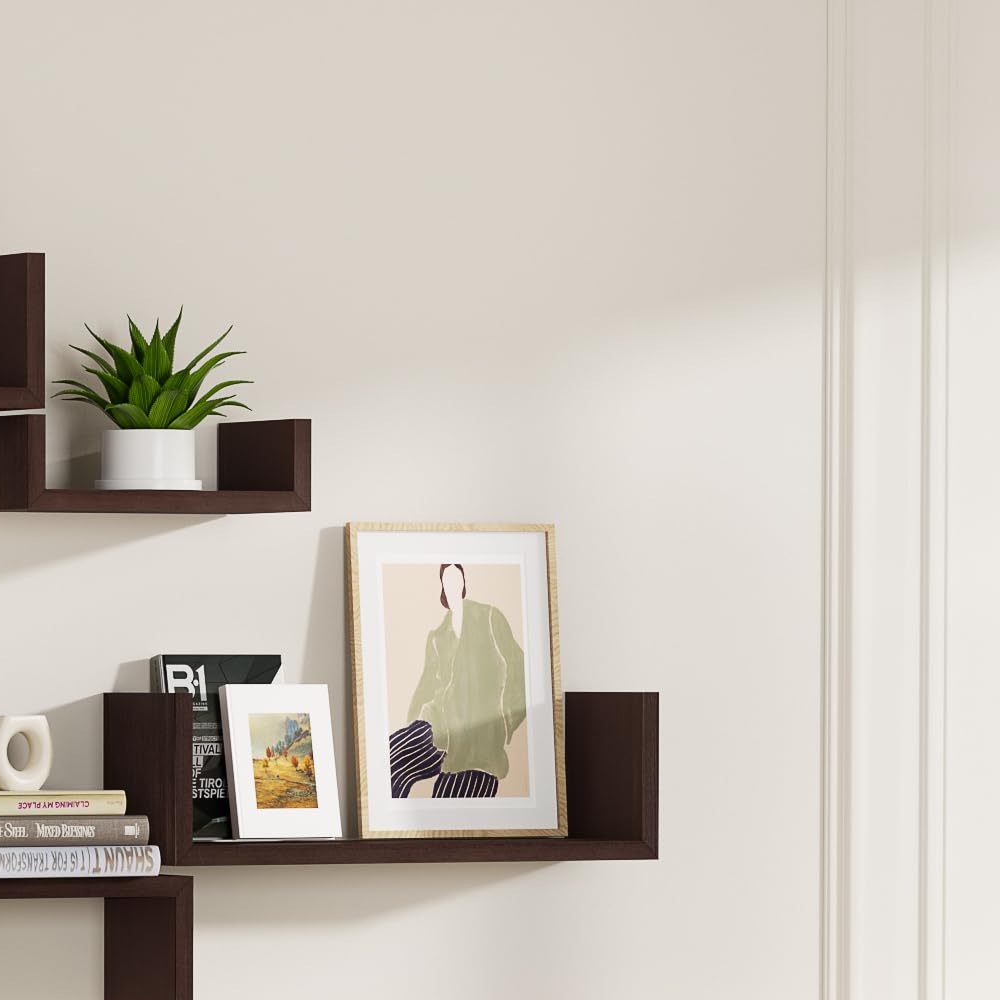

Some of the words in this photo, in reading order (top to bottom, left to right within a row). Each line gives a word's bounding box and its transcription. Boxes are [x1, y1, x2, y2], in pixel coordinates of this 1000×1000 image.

[17, 801, 41, 809] PLACE
[42, 801, 54, 809] MY
[55, 800, 90, 809] CLAIMING
[52, 850, 68, 873] FOR
[92, 847, 102, 874] T
[103, 846, 154, 874] SHAUN
